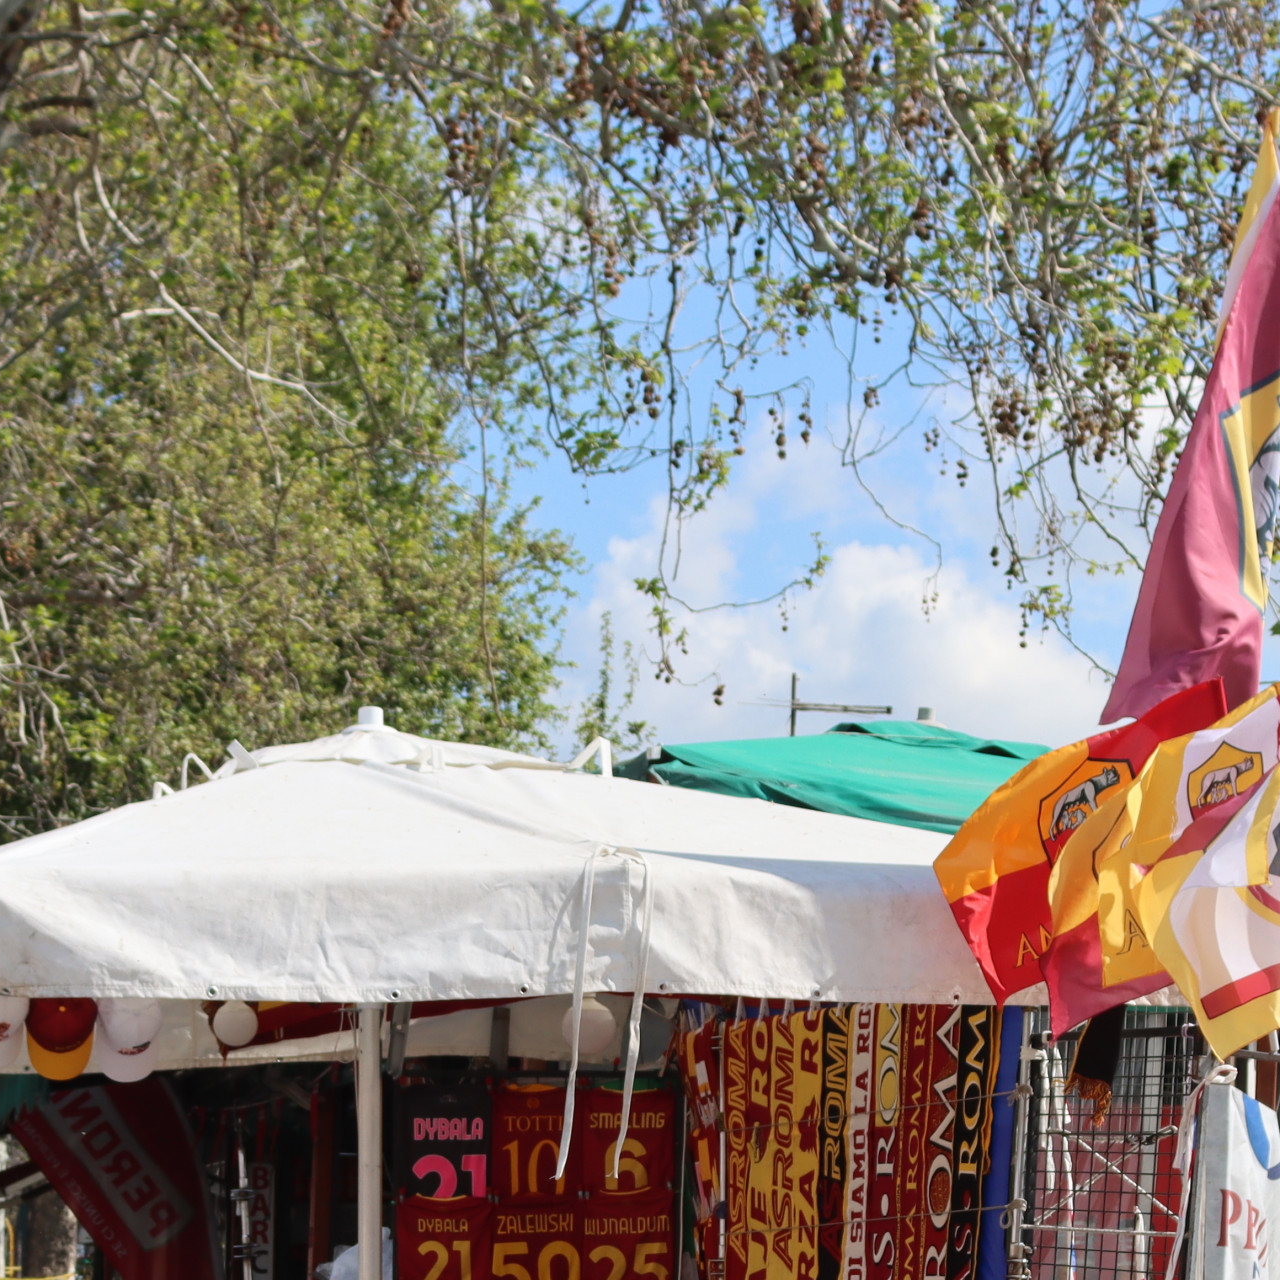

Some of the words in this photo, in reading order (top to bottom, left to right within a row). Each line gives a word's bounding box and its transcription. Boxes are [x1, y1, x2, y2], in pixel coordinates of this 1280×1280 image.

[857, 1002, 872, 1049] RO
[853, 1071, 869, 1114] LA
[413, 1117, 484, 1141] DYBALA
[504, 1115, 563, 1132] TOTTI
[590, 1112, 665, 1130] SMALING
[907, 1061, 924, 1191] ROMA
[412, 1154, 487, 1198] 21
[502, 1139, 566, 1196] 10
[604, 1138, 648, 1191] 6
[850, 1127, 866, 1244] SIAMO
[418, 1218, 468, 1233] DYBALA
[497, 1214, 574, 1234] ZALEWSKI
[584, 1215, 670, 1236] WIJNALDUM
